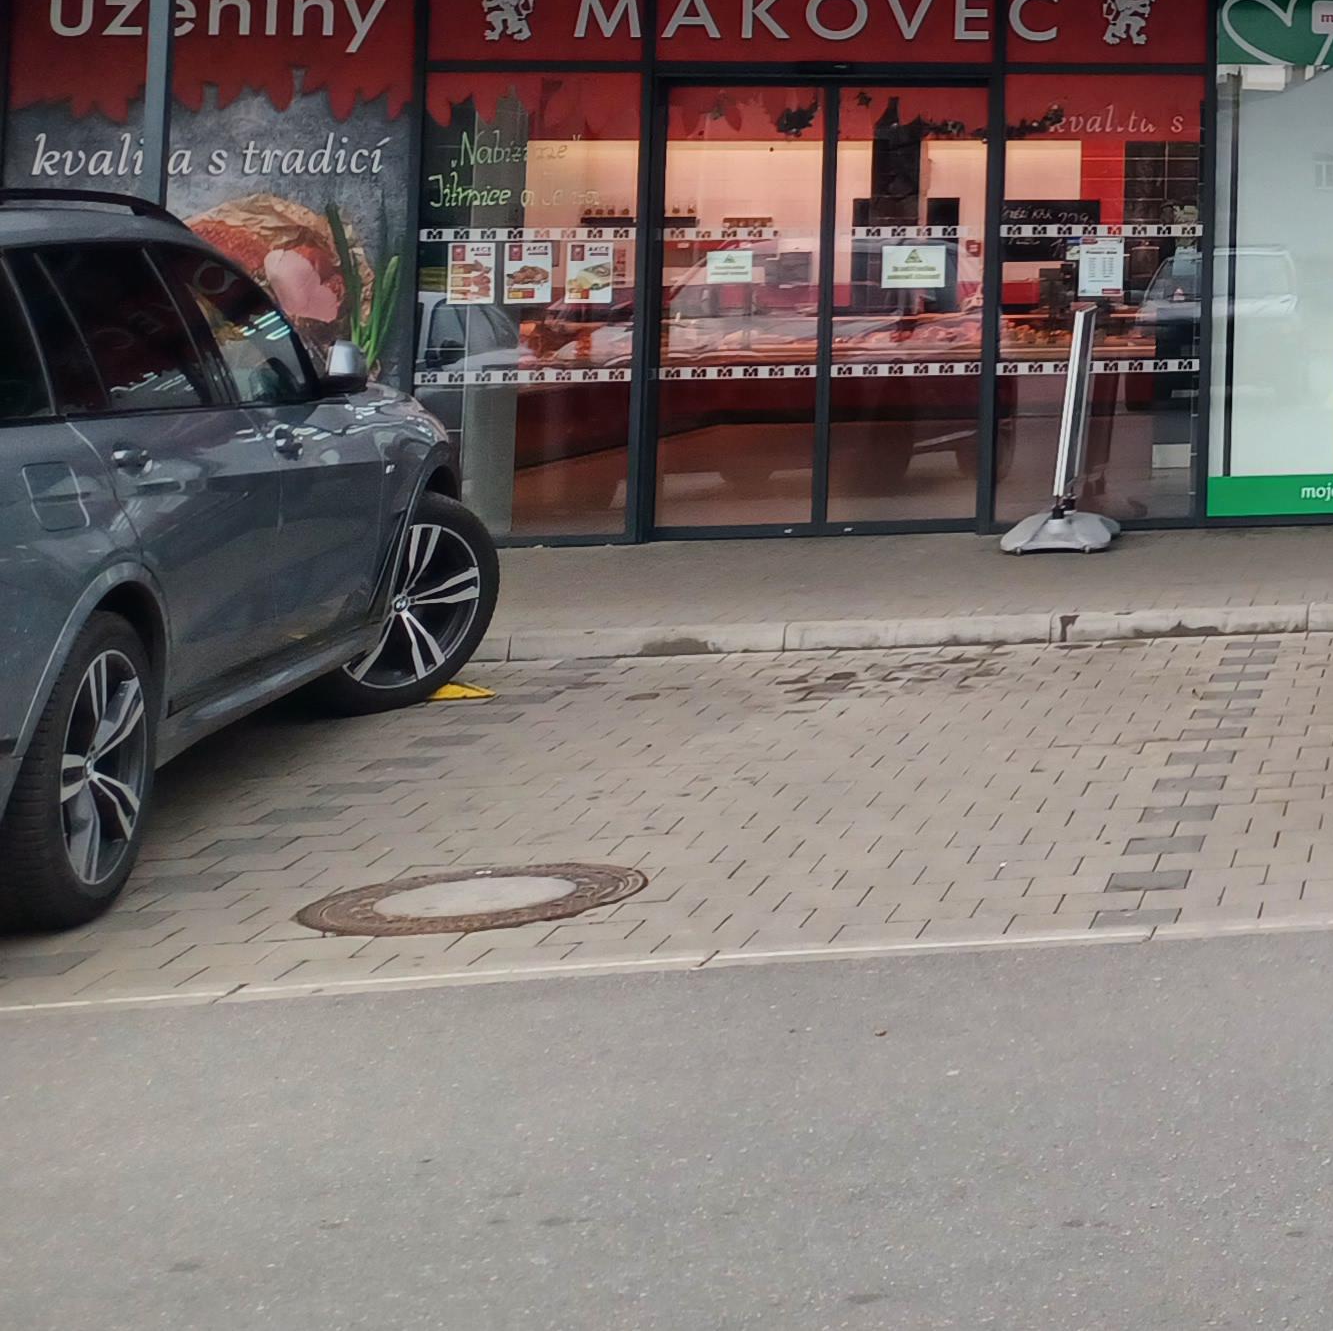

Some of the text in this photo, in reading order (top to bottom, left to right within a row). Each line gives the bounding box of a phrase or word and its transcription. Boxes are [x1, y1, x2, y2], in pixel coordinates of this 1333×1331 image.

[31, 133, 392, 176] kvalia s tradicí
